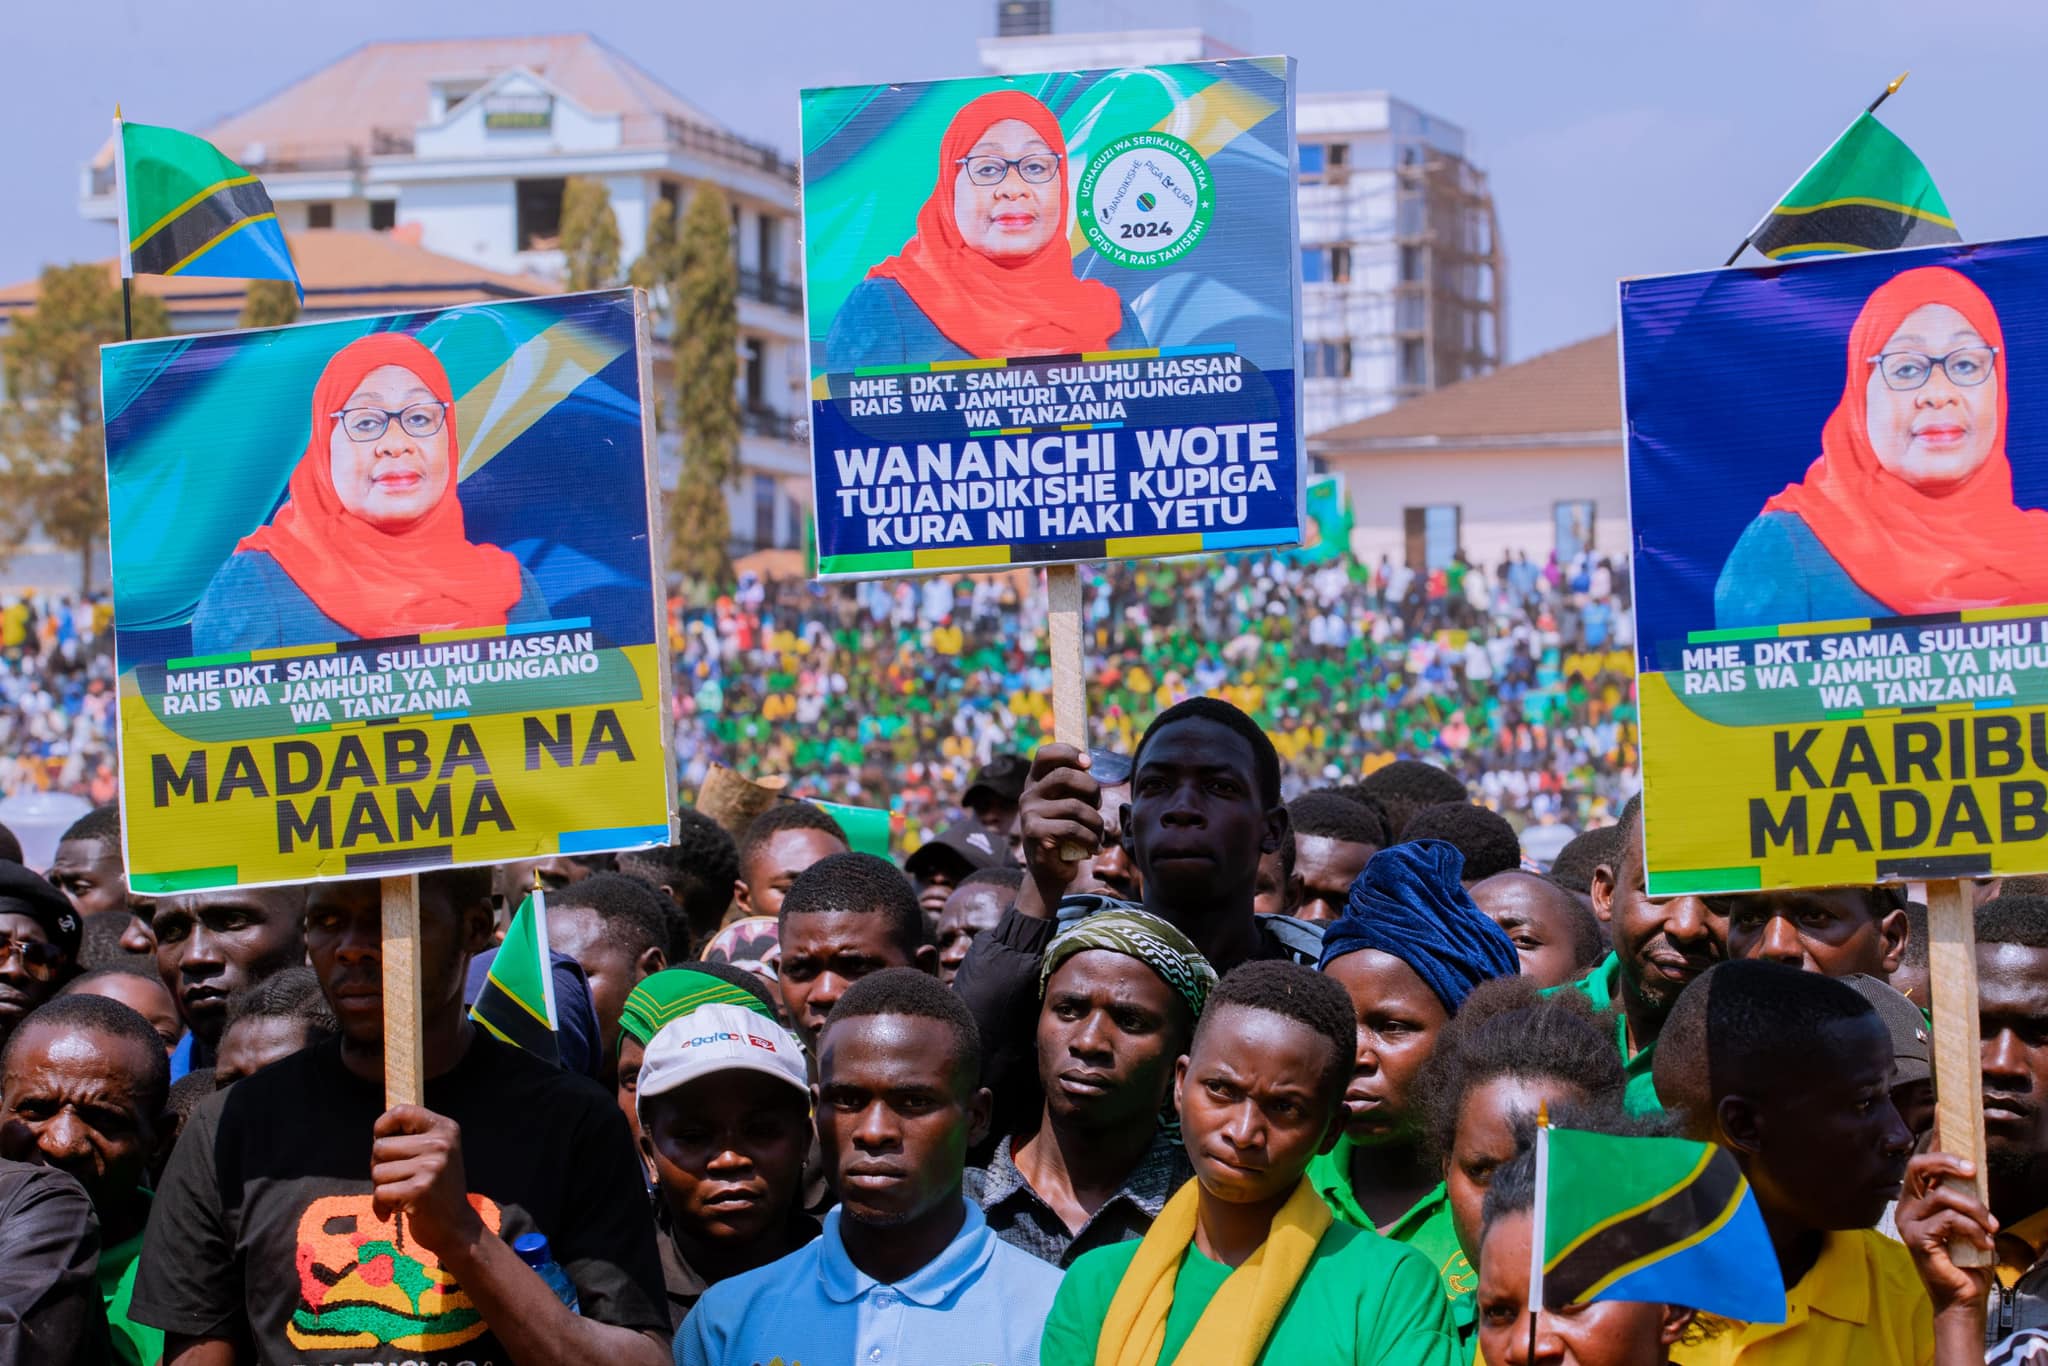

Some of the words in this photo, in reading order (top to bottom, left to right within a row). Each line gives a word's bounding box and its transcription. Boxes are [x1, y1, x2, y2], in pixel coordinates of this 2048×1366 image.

[1081, 149, 1114, 198] UCHAGUZI
[1114, 140, 1132, 152] WA
[1132, 136, 1179, 151] SERIKALI
[1178, 148, 1190, 161] ZA
[1189, 160, 1208, 190] MITAA
[1144, 160, 1164, 180] PIGA
[1173, 185, 1193, 208] KURA
[1089, 227, 1112, 254] OFISI
[1114, 250, 1126, 262] YA
[1130, 254, 1156, 265] RAIS
[1159, 220, 1205, 262] TAMISEMI
[1120, 222, 1173, 238] 2024
[850, 379, 902, 398] MHE.
[910, 375, 958, 394] DKT.
[966, 370, 1038, 390] SAMIA
[1047, 363, 1139, 386] SULUHU
[1148, 356, 1242, 378] HASSAN
[850, 397, 902, 416] RAIS
[910, 394, 947, 412] WA
[955, 388, 1056, 410] JAMHURI
[1065, 385, 1096, 402] YA
[1105, 376, 1242, 400] MUUNGANO
[964, 410, 1000, 428] WA
[1008, 402, 1127, 426] TANZANIA
[834, 432, 1114, 487] WANANCHI
[1136, 422, 1278, 468] WOTE
[836, 474, 1116, 518] TUJIANDIKISHE
[1130, 464, 1277, 500] KUPIGA
[868, 512, 973, 546] KURA
[988, 510, 1024, 540] NI
[1040, 503, 1133, 536] HAKI
[1147, 496, 1247, 530] YETU
[286, 656, 368, 682] SAMIA
[376, 644, 480, 673] SULUHU
[489, 632, 594, 662] HASSAN
[1682, 646, 1746, 671] MHE.
[1754, 640, 1812, 666] DKT.
[1820, 633, 1909, 660] SAMIA
[1918, 622, 2032, 654] SULUHU
[163, 692, 222, 716] RAIS
[230, 688, 270, 708] WA
[280, 673, 392, 704] JAMHURI
[402, 669, 438, 690] YA
[446, 654, 599, 687] MUUNGANO
[1684, 670, 1746, 695] RAIS
[1754, 666, 1799, 690] WA
[1808, 656, 1930, 686] JAMHURI
[1940, 652, 1979, 676] YA
[1820, 685, 1864, 708] WA
[1872, 673, 2016, 705] TANZANIA
[290, 702, 332, 724] WA
[340, 688, 472, 719] TANZANIA
[152, 723, 492, 808] MADABA
[522, 708, 636, 772] NA
[276, 778, 516, 854] MAMA
[1748, 780, 2048, 858] MADAB
